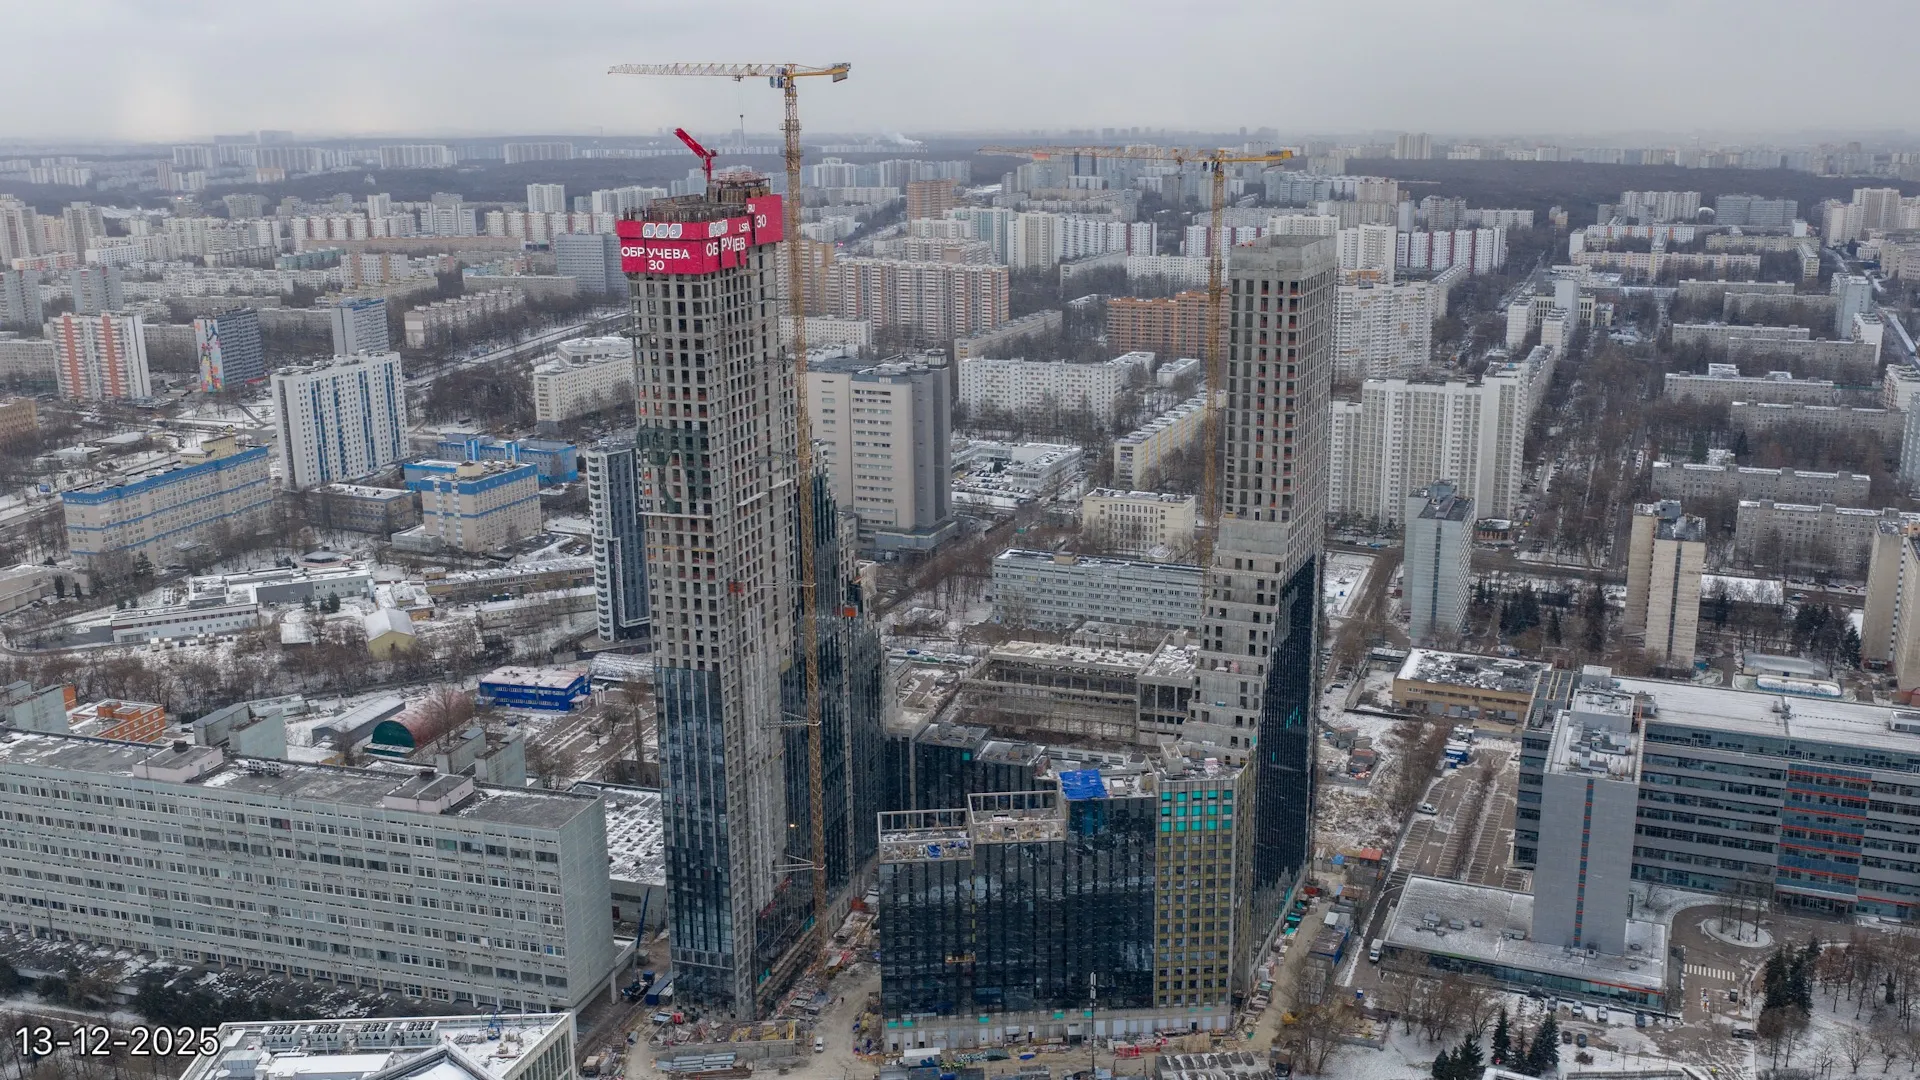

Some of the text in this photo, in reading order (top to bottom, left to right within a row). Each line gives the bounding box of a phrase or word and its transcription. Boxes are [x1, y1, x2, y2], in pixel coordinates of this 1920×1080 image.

[756, 214, 767, 228] 30
[621, 246, 690, 259] ОБРУЧЕВА
[648, 260, 665, 270] 30
